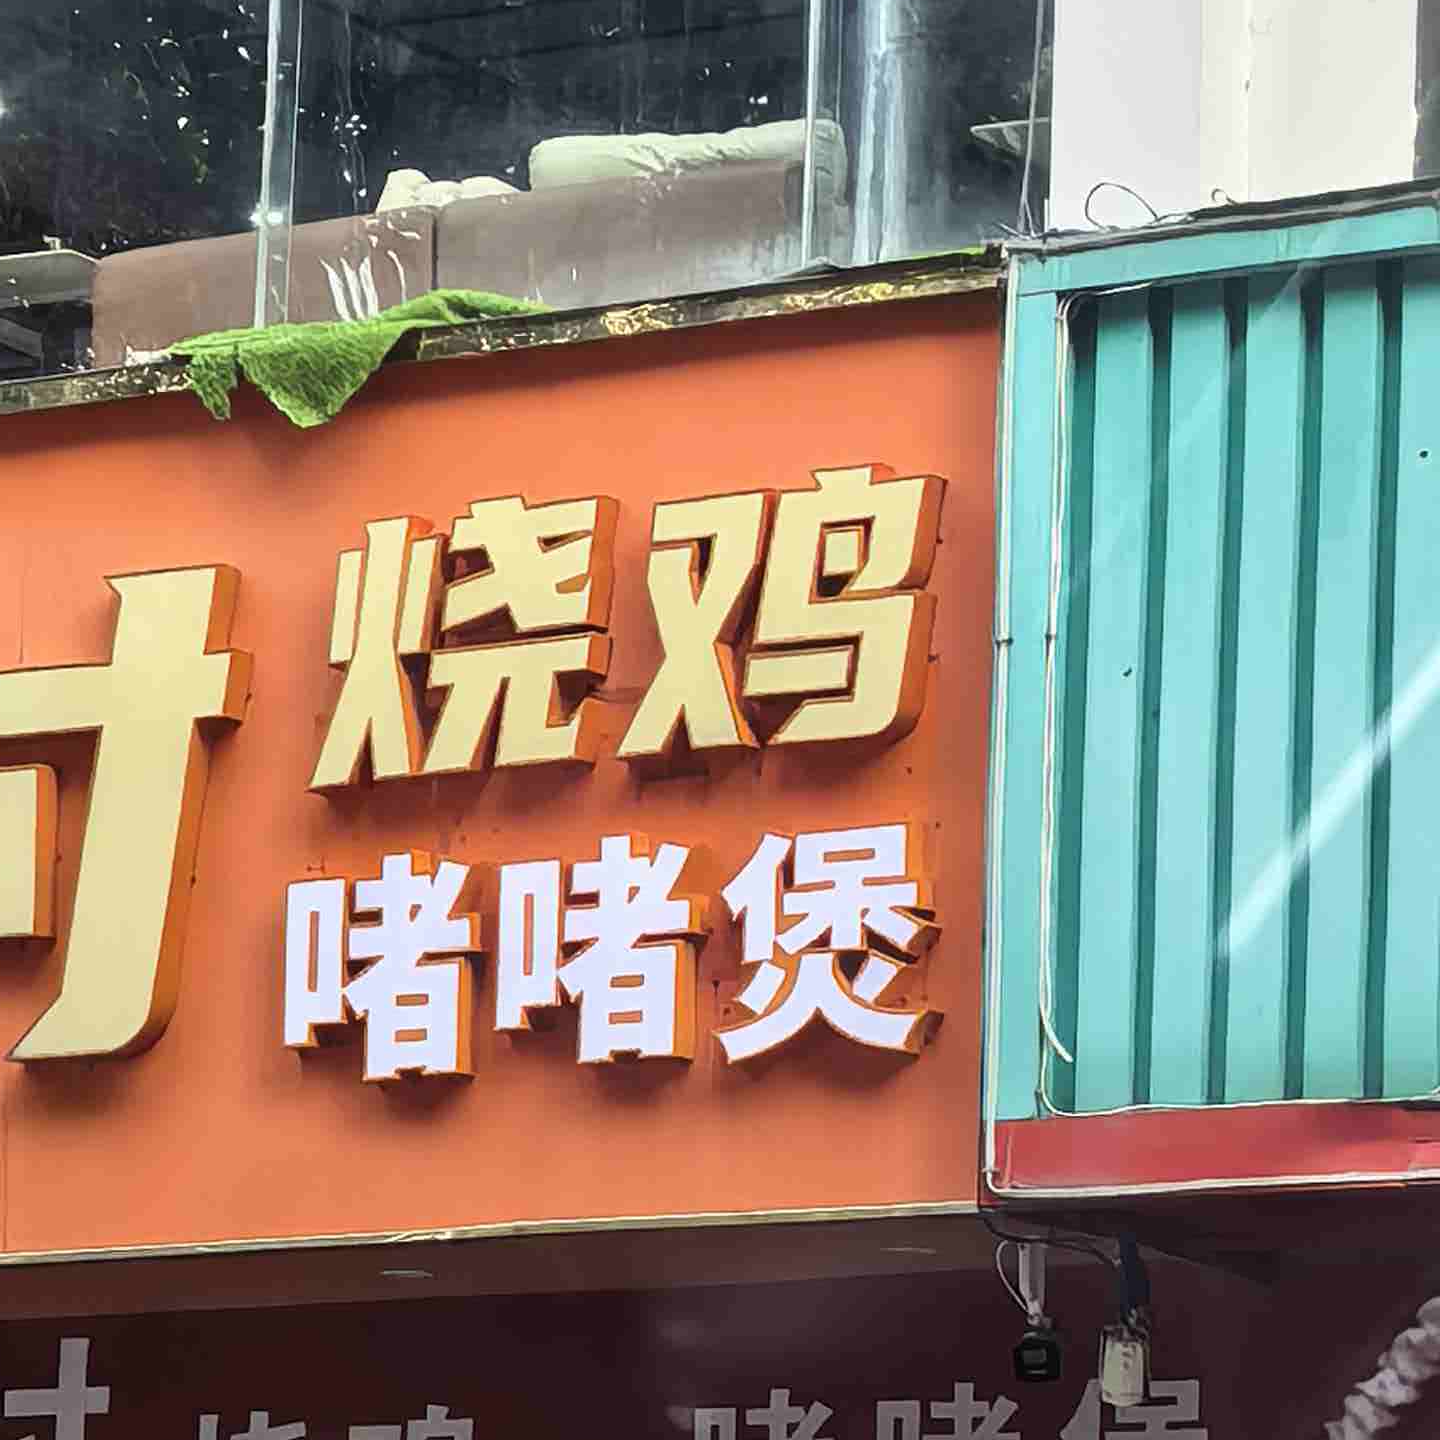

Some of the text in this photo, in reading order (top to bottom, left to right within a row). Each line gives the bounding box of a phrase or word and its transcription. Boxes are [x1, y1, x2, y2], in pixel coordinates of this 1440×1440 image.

[307, 463, 950, 797] 烧鸡
[283, 820, 946, 1086] 啫啫煲
